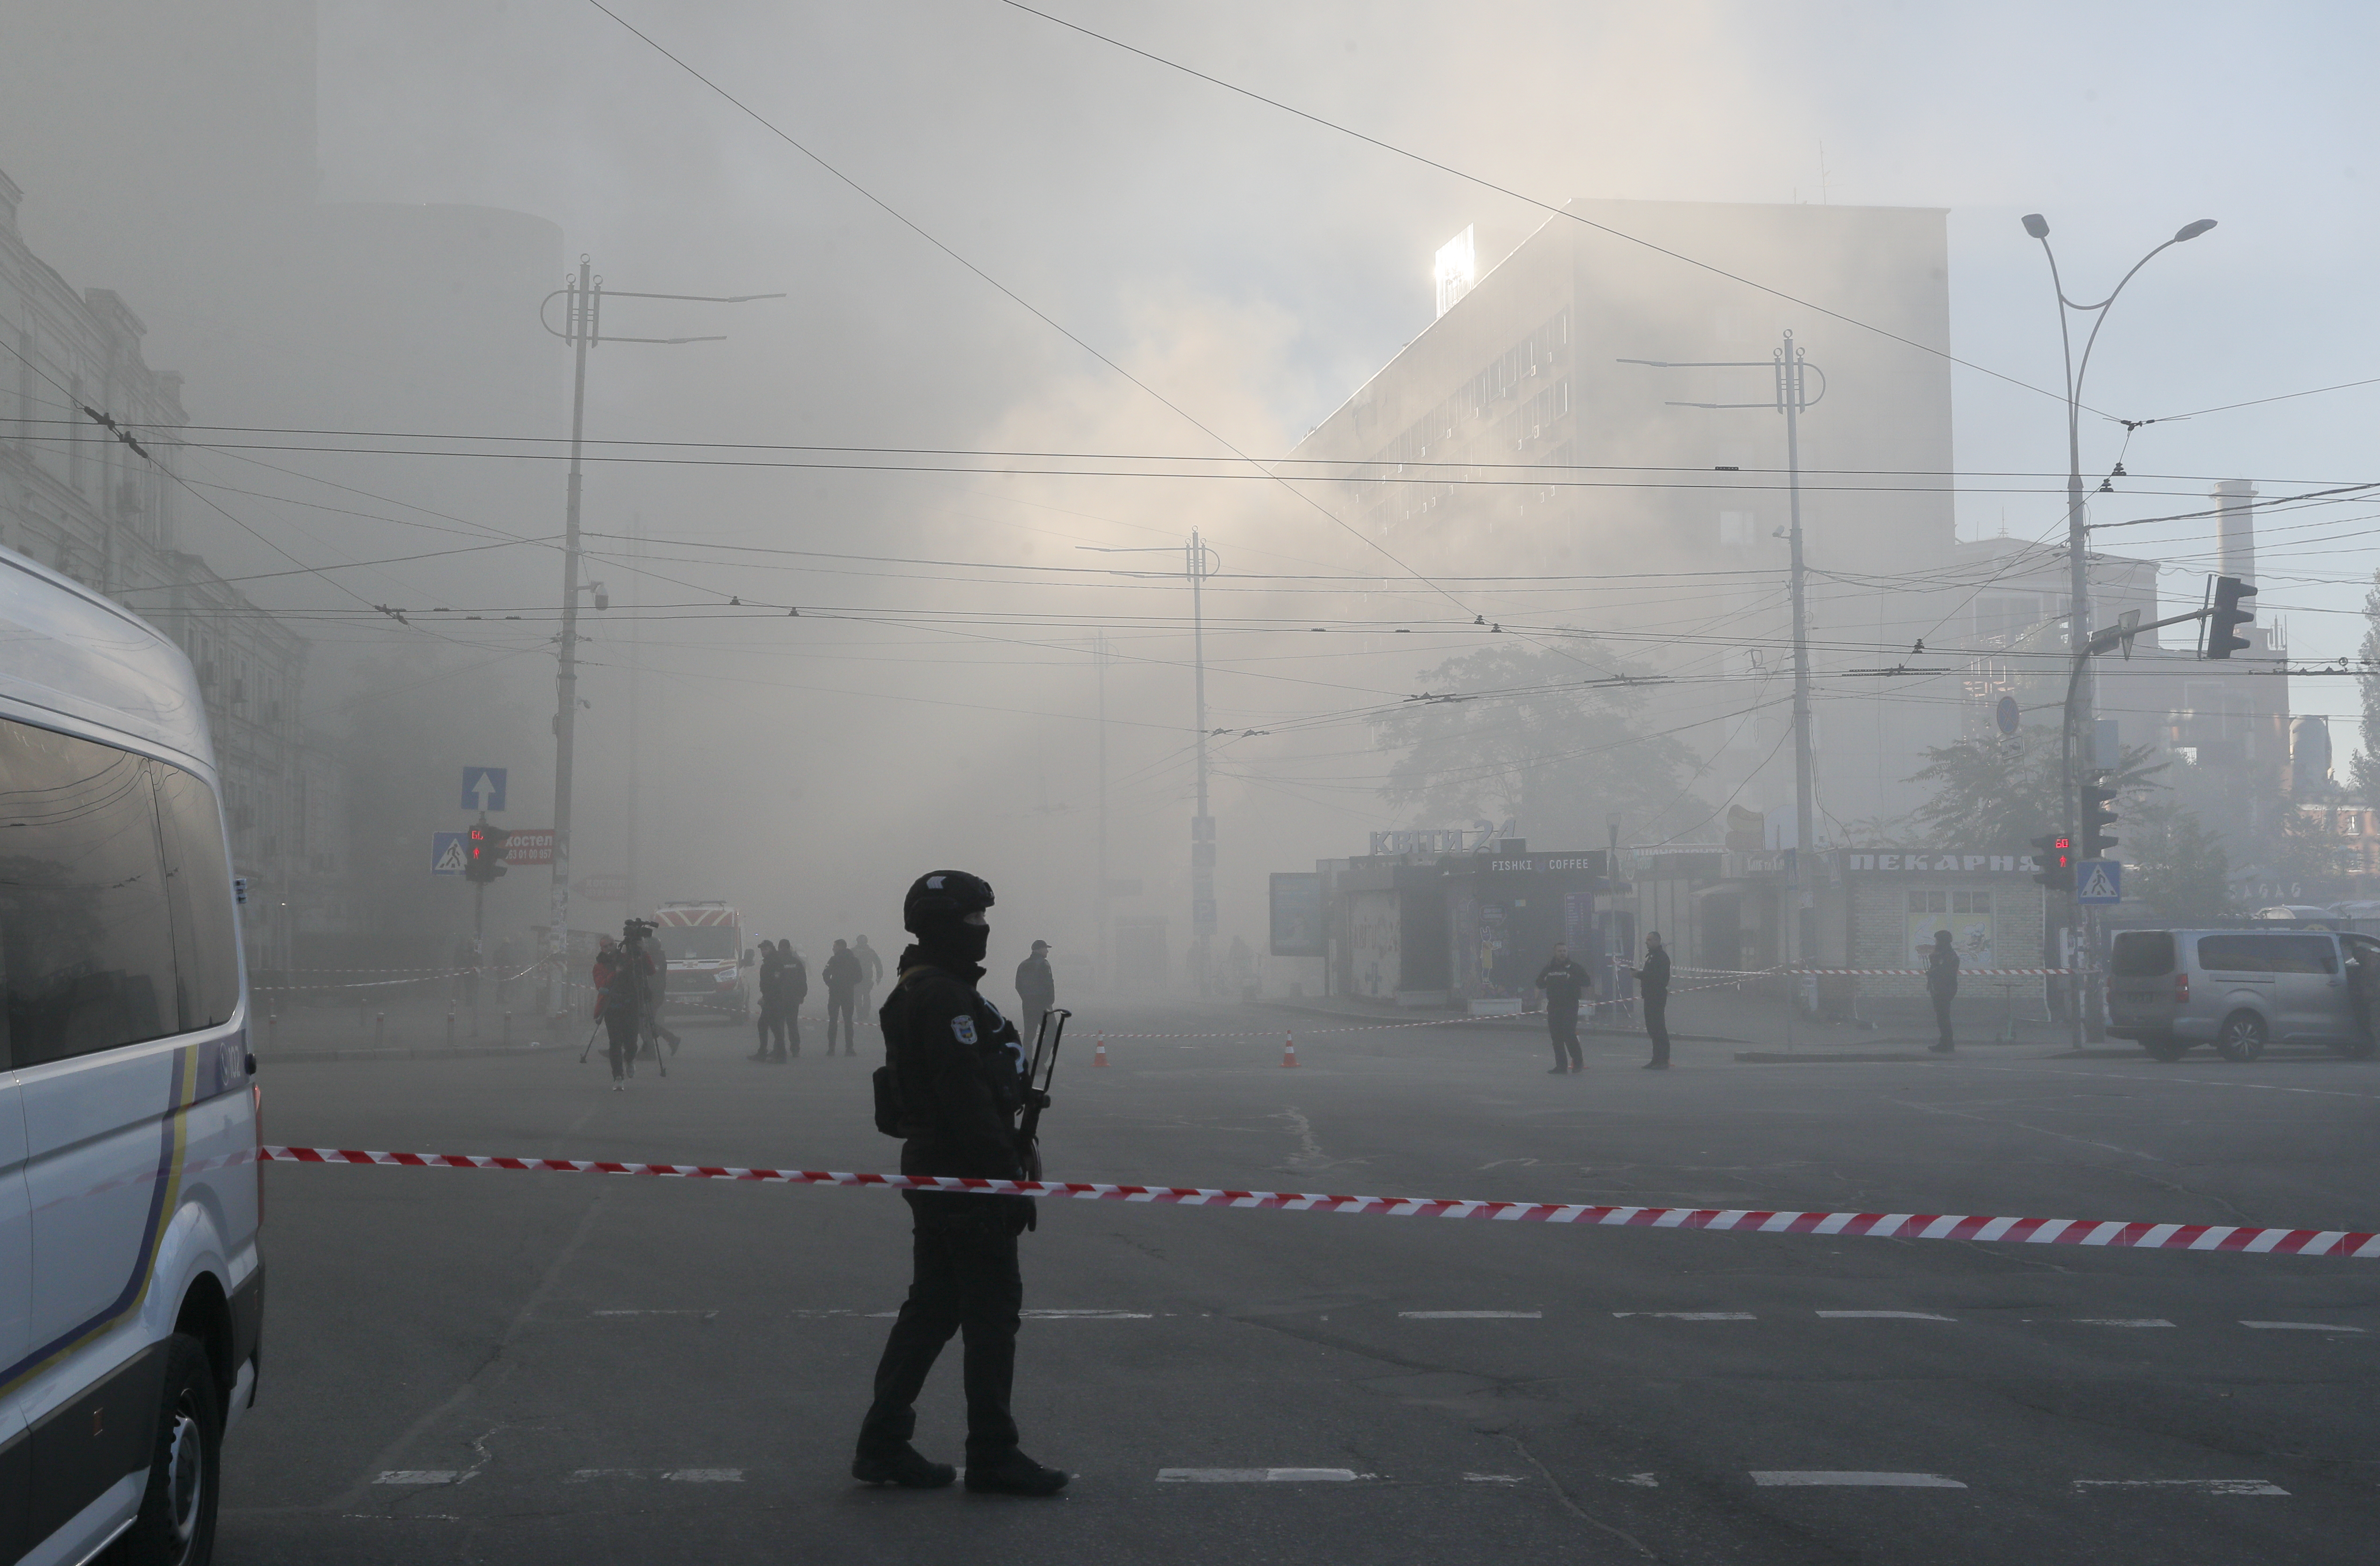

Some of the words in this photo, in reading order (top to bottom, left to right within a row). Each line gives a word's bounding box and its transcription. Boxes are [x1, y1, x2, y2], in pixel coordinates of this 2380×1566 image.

[1369, 829, 1462, 855] КВІТИ
[1470, 819, 1516, 853] 24
[2056, 839, 2068, 848] 60
[505, 849, 517, 859] 63
[519, 849, 527, 859] 01
[528, 849, 537, 859] 00
[539, 849, 552, 859] 957
[1492, 860, 1532, 871] FISHKI
[1549, 858, 1589, 870] COFFEE
[1850, 854, 2040, 872] ПЕКАРНЯ
[228, 1045, 240, 1079] 102
